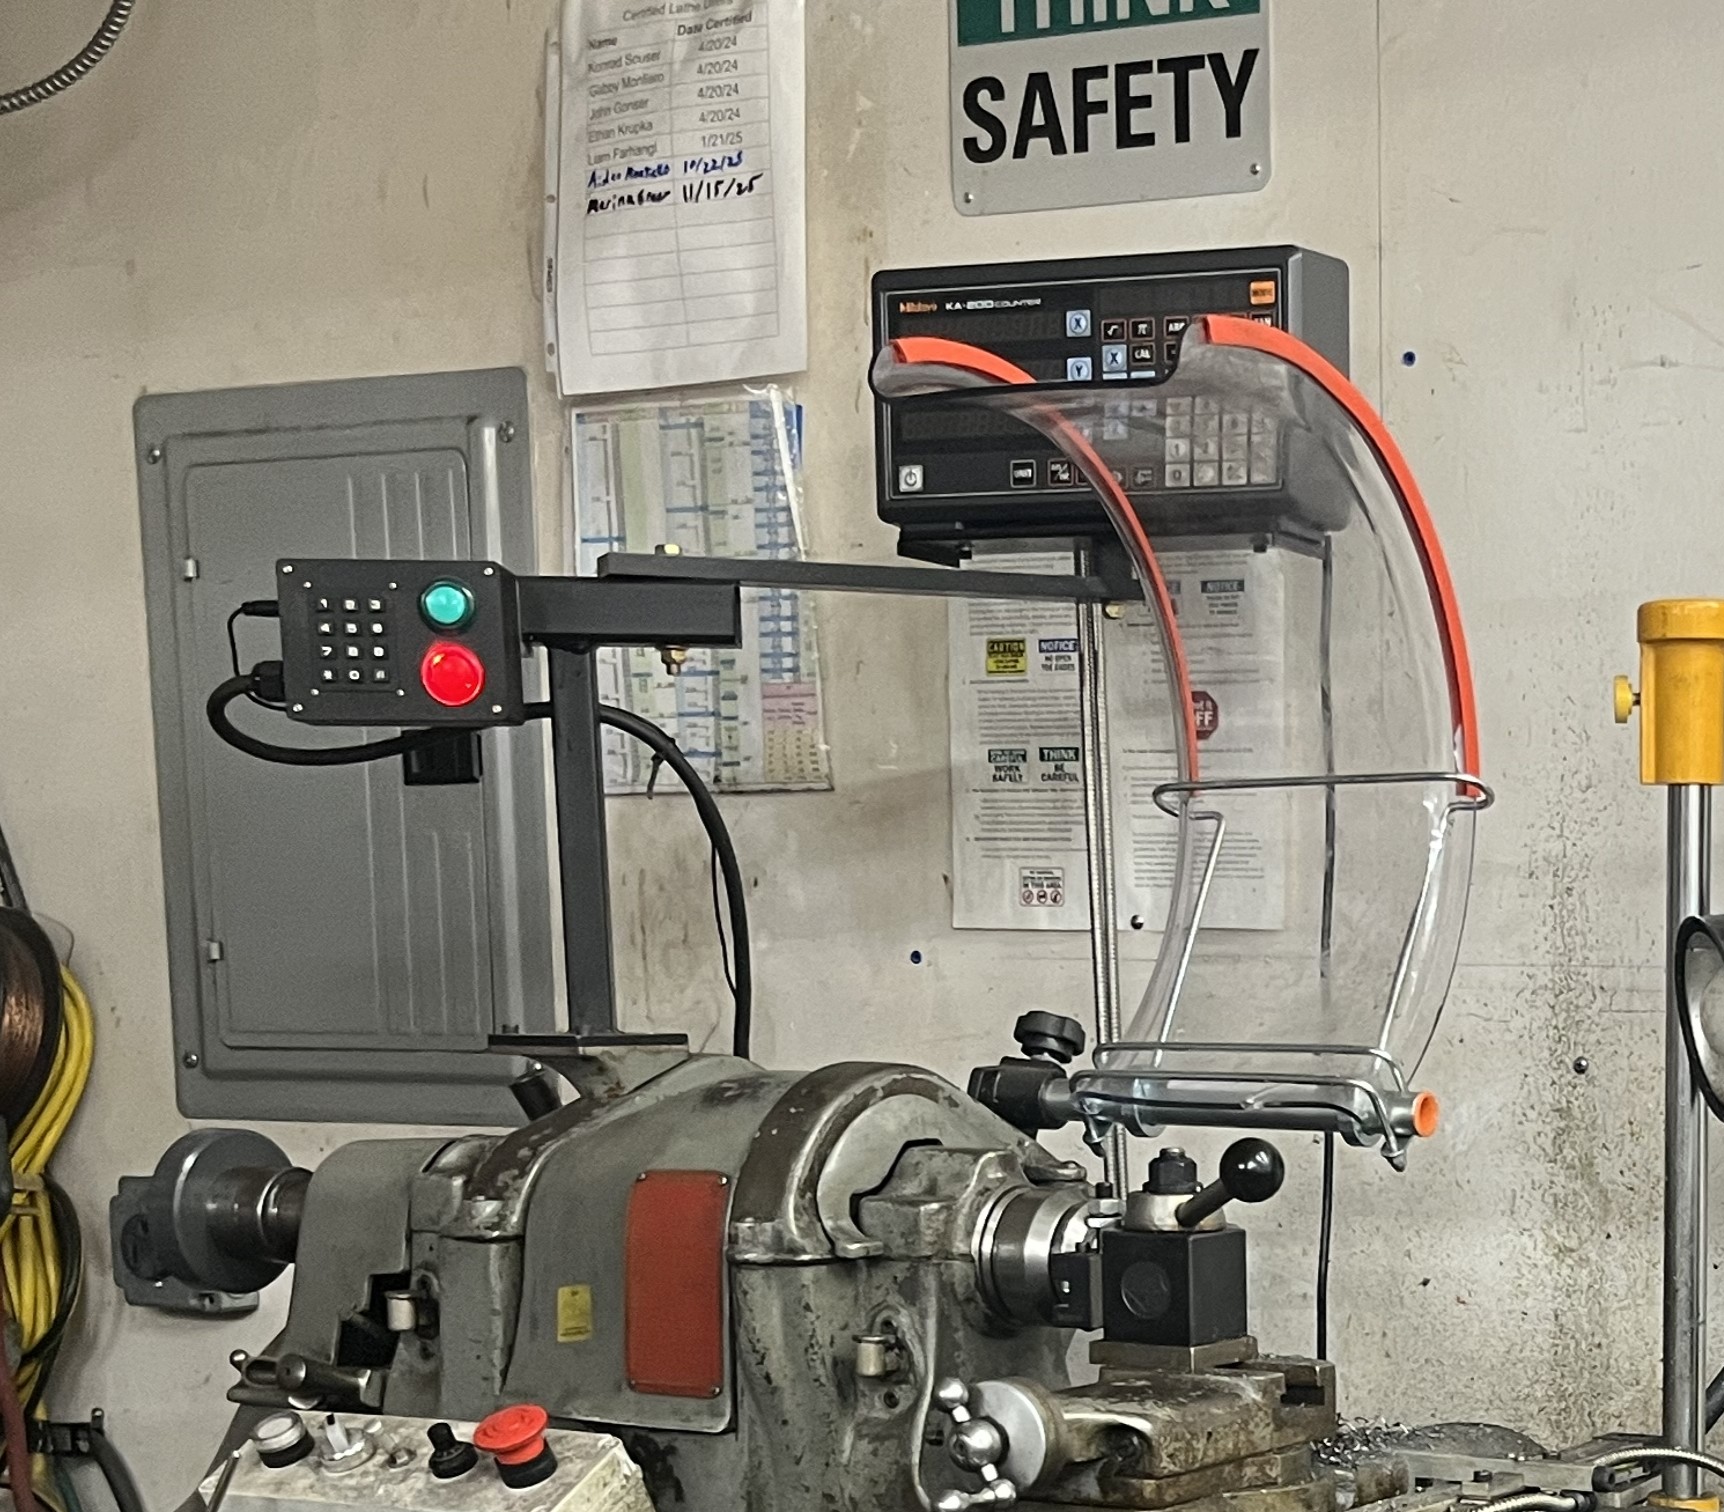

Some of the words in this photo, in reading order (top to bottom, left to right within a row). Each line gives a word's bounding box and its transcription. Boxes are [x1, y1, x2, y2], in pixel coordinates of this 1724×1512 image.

[697, 59, 738, 75] 4/20/24
[697, 83, 739, 98] 4/20/24
[962, 48, 1260, 164] SAFETY
[699, 108, 741, 123] 4/20/24
[702, 131, 743, 148] 1/21/25
[1073, 317, 1082, 330] X
[1110, 352, 1118, 364] X
[1075, 365, 1083, 377] Y
[1040, 640, 1076, 651] NOTICE
[1042, 749, 1076, 760] THINK
[1041, 773, 1079, 782] CAREFUL
